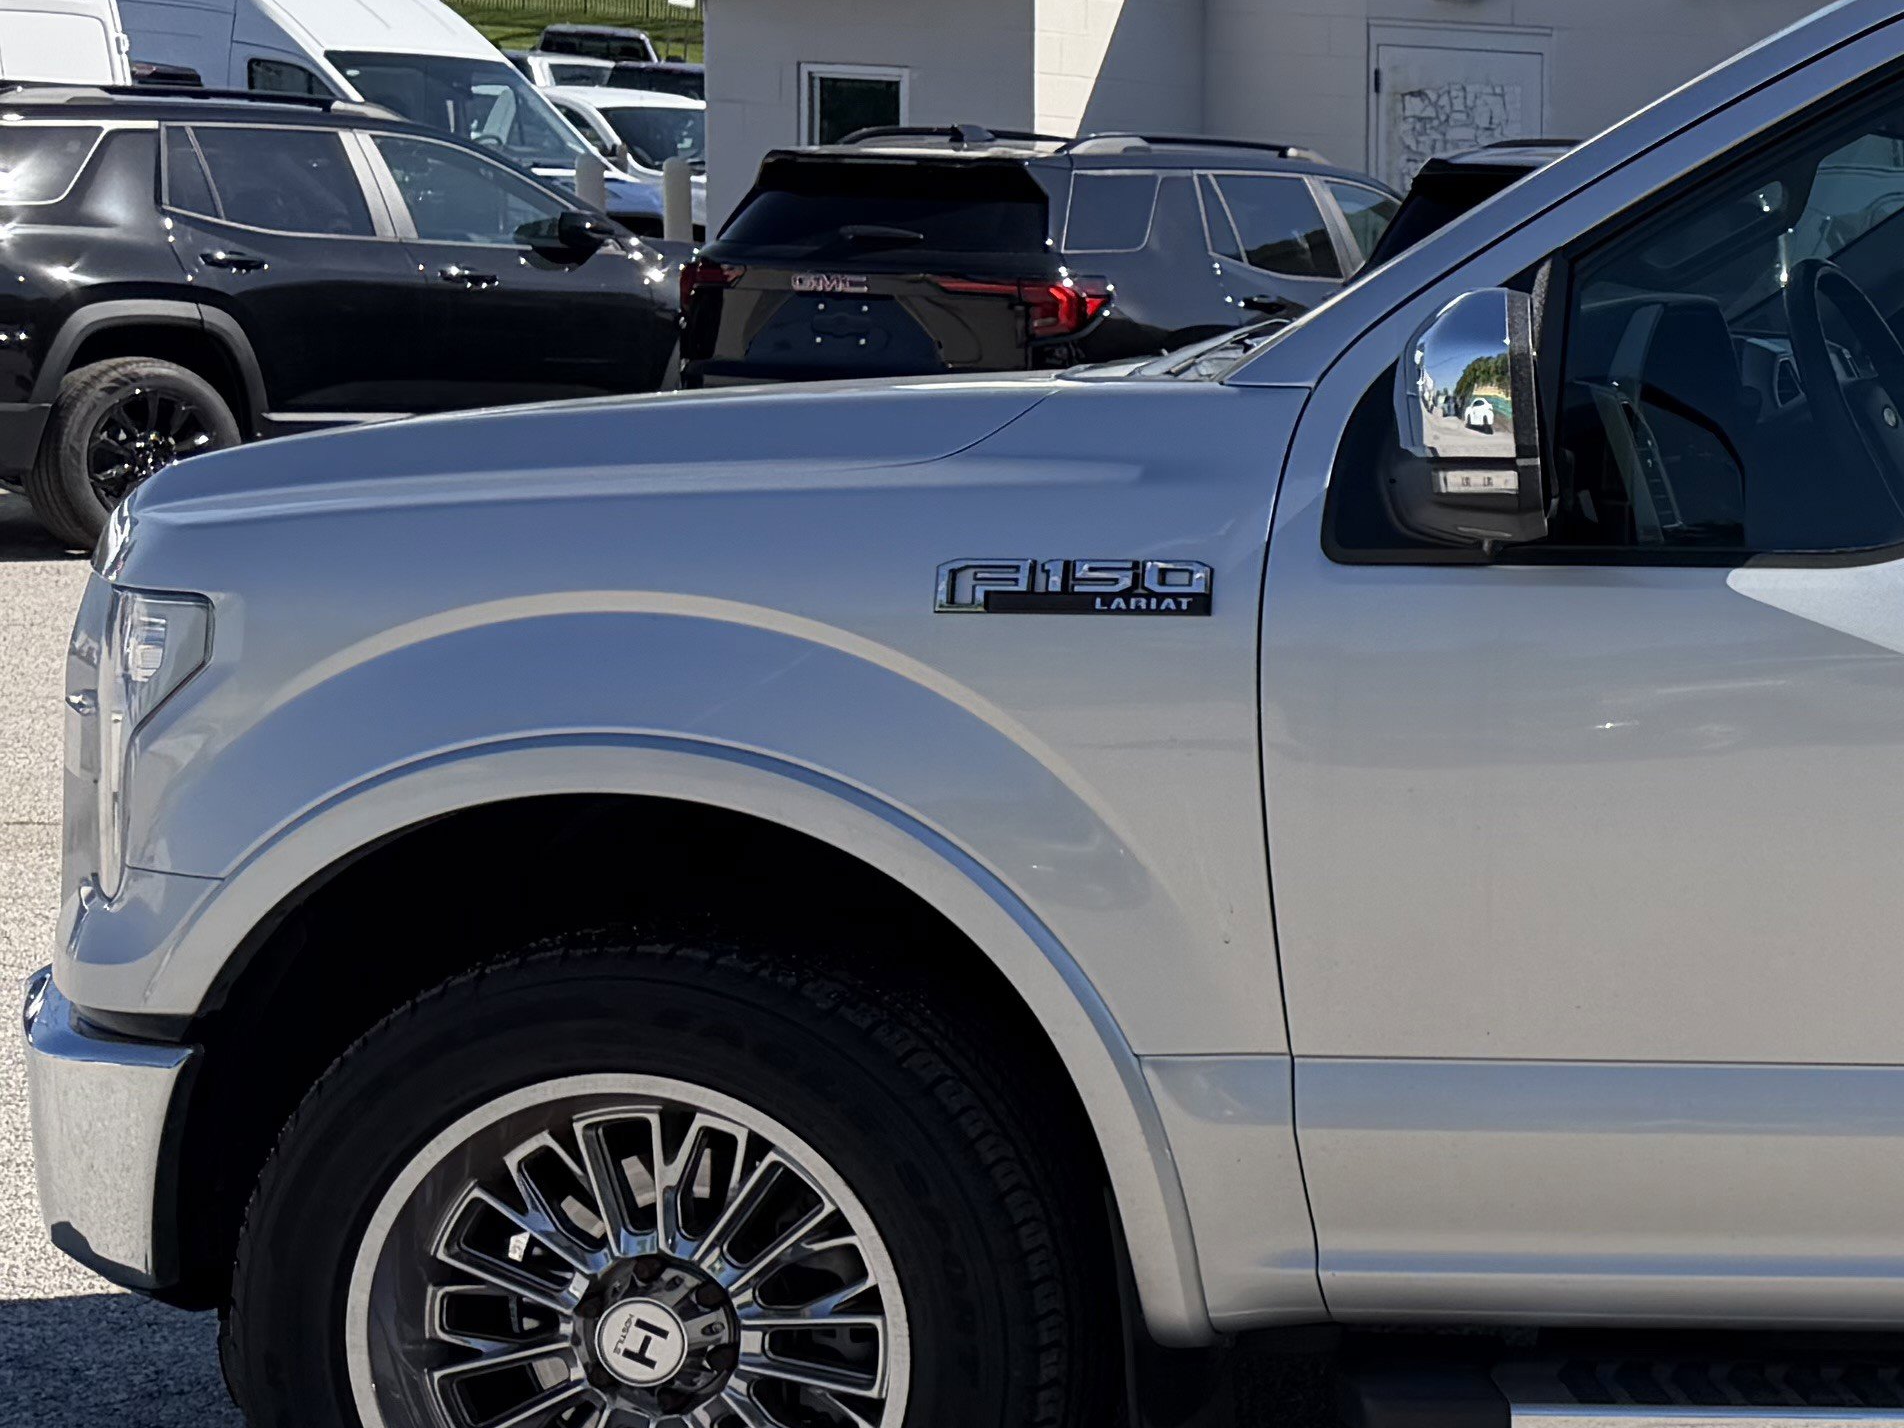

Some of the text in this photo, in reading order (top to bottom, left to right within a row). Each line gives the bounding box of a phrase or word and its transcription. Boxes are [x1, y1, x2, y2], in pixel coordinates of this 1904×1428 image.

[791, 273, 868, 293] GMC
[1094, 596, 1194, 612] LARIAT
[622, 1318, 670, 1371] H
